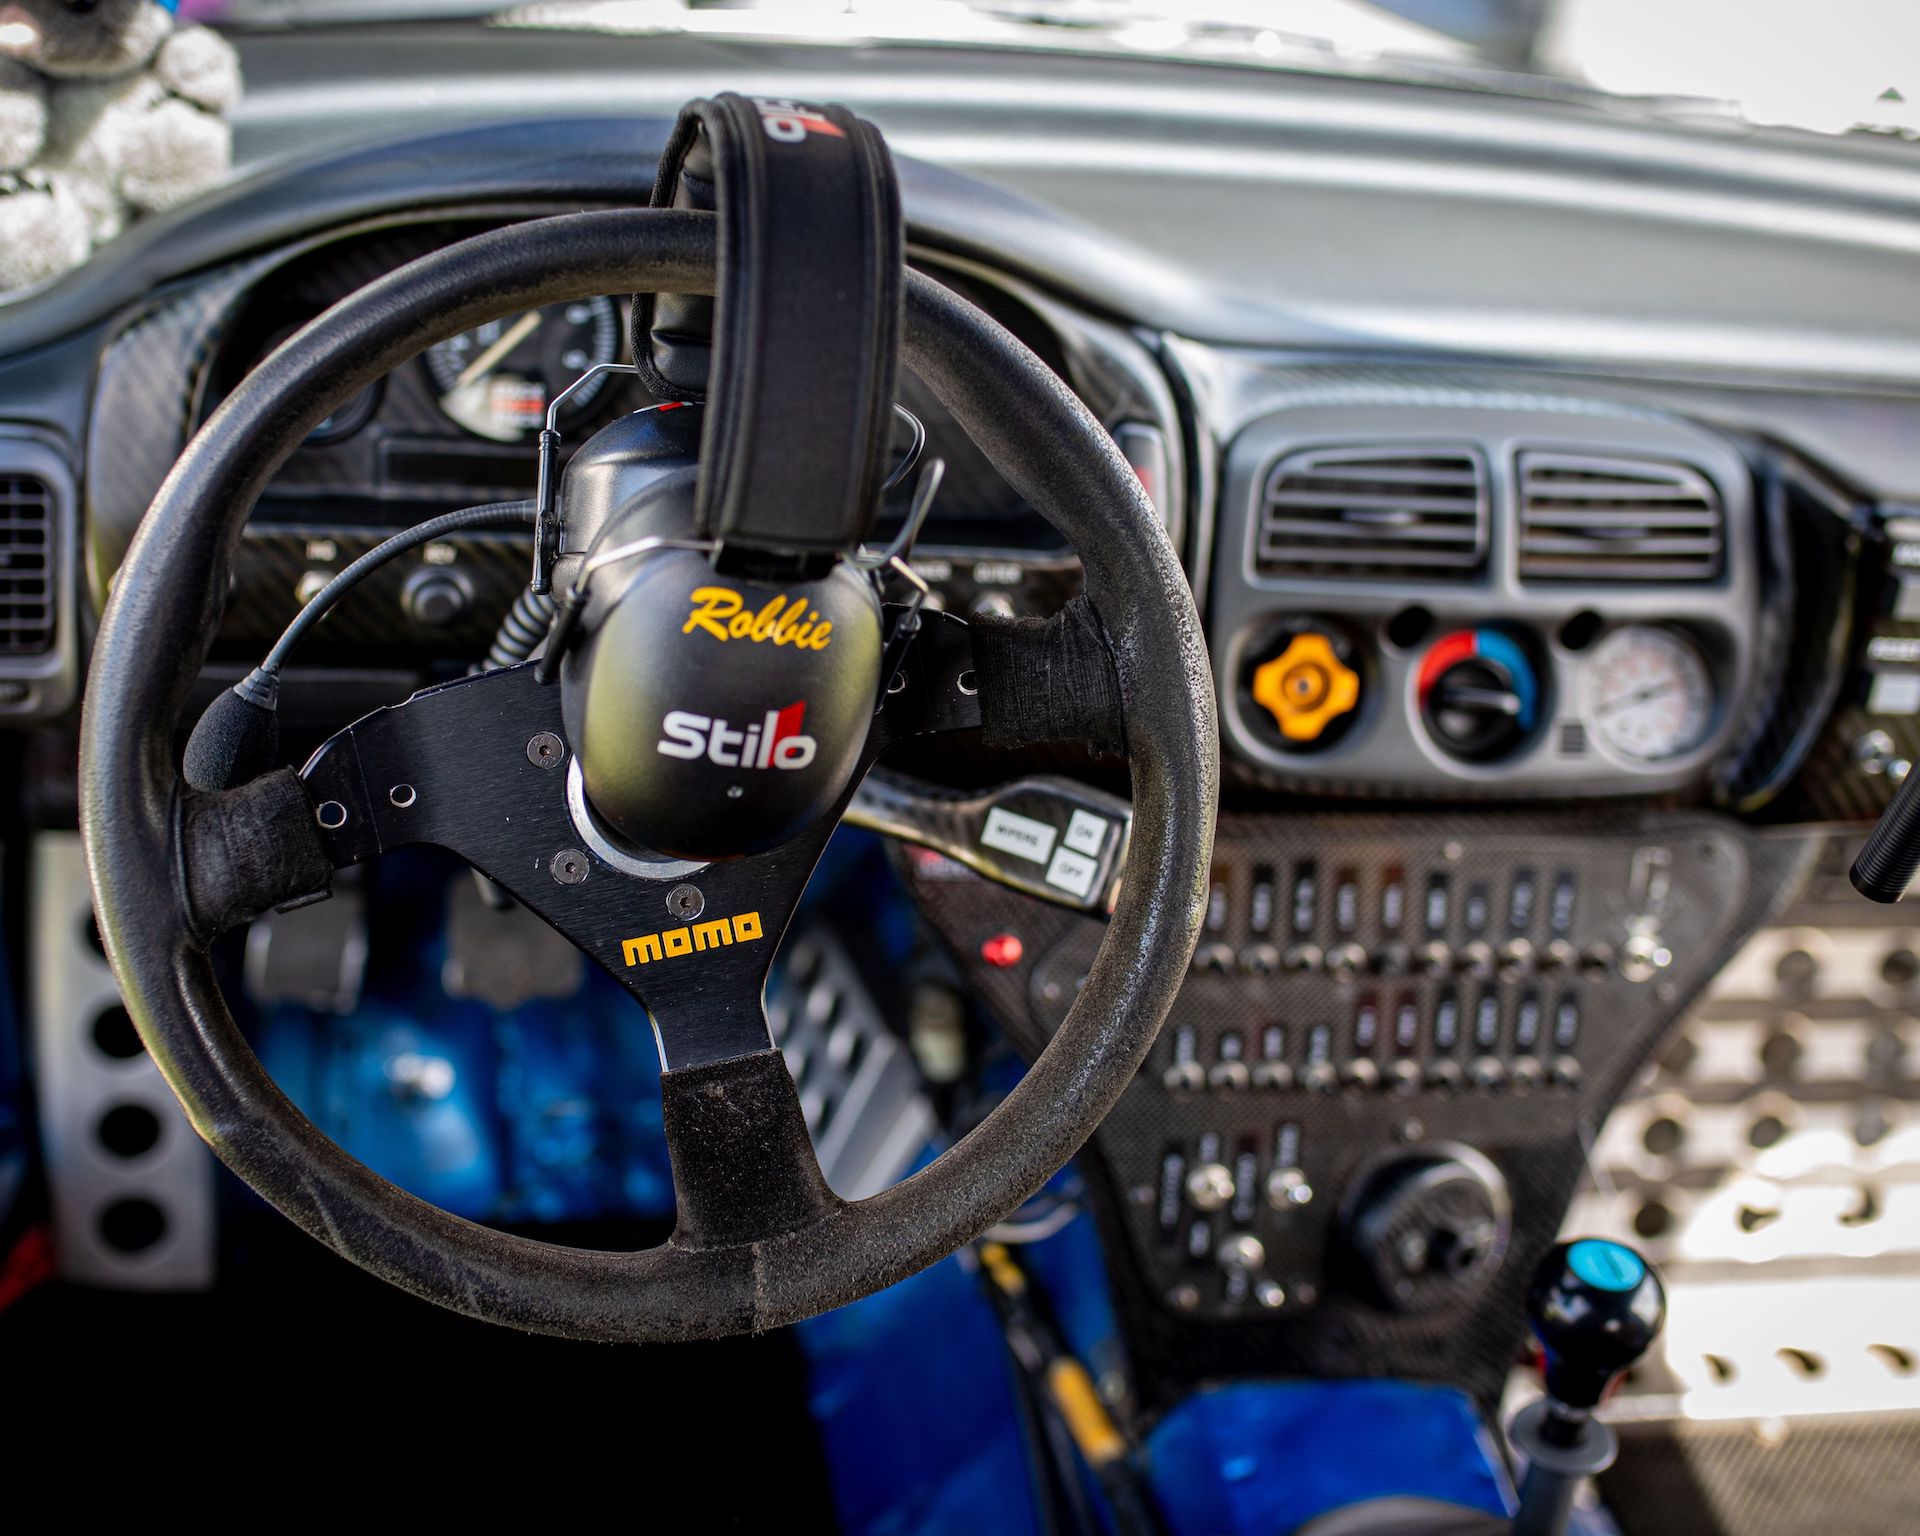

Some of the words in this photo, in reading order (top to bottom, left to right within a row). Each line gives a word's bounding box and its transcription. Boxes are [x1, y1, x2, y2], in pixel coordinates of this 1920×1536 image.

[682, 586, 833, 650] Robbie
[657, 700, 817, 769] Stilo
[996, 823, 1039, 848] WIPERS
[1075, 825, 1093, 839] ON
[1059, 862, 1083, 879] OFF
